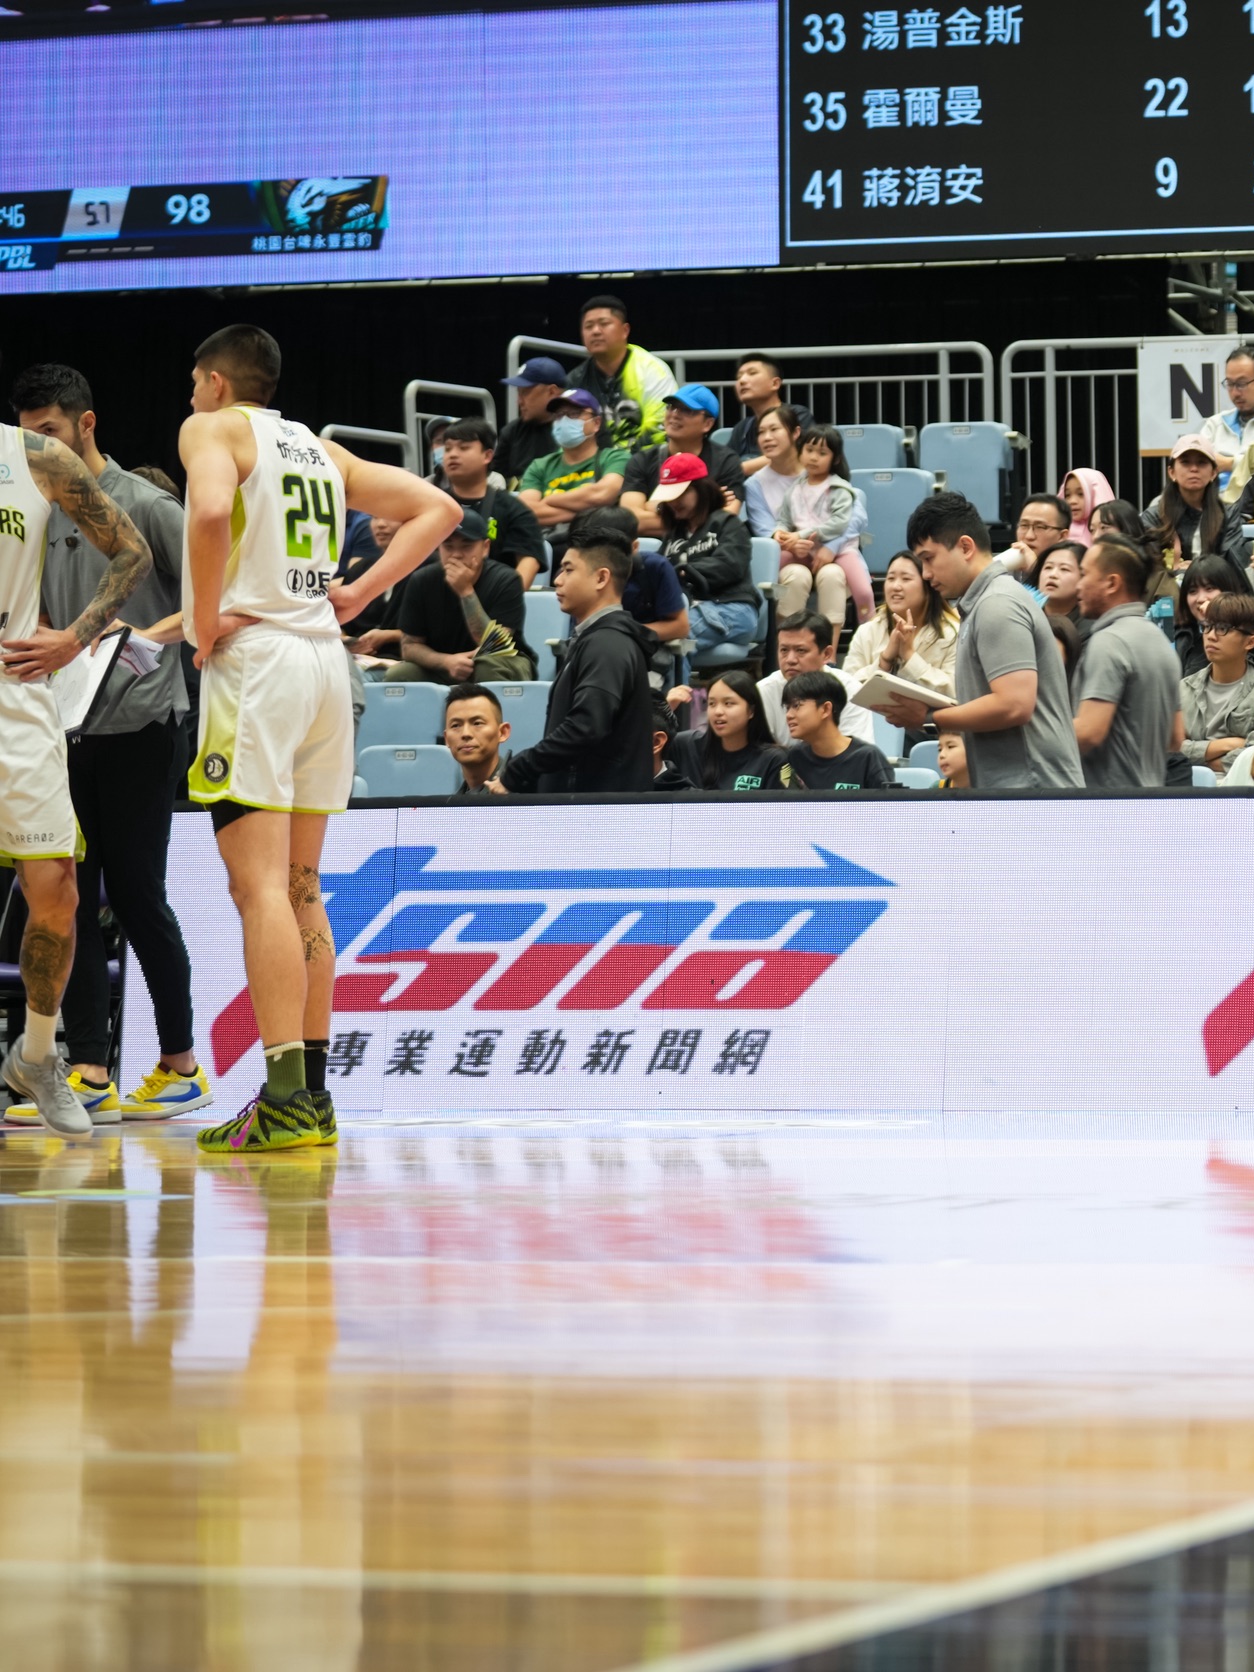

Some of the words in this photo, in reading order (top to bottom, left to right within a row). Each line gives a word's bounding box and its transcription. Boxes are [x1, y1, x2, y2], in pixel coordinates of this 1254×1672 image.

[803, 12, 847, 54] 33
[862, 4, 1024, 50] 湯普金斯
[1144, 0, 1190, 38] 13
[803, 91, 847, 132] 35
[862, 85, 983, 129] 霍爾曼
[1143, 77, 1189, 118] 22
[165, 193, 211, 226] 98
[802, 169, 843, 210] 41
[862, 163, 984, 208] 蔣淯安
[1155, 156, 1178, 198] 9
[1169, 362, 1216, 420] N
[281, 472, 339, 563] 24
[327, 1027, 771, 1077] 專業運動新聞網
